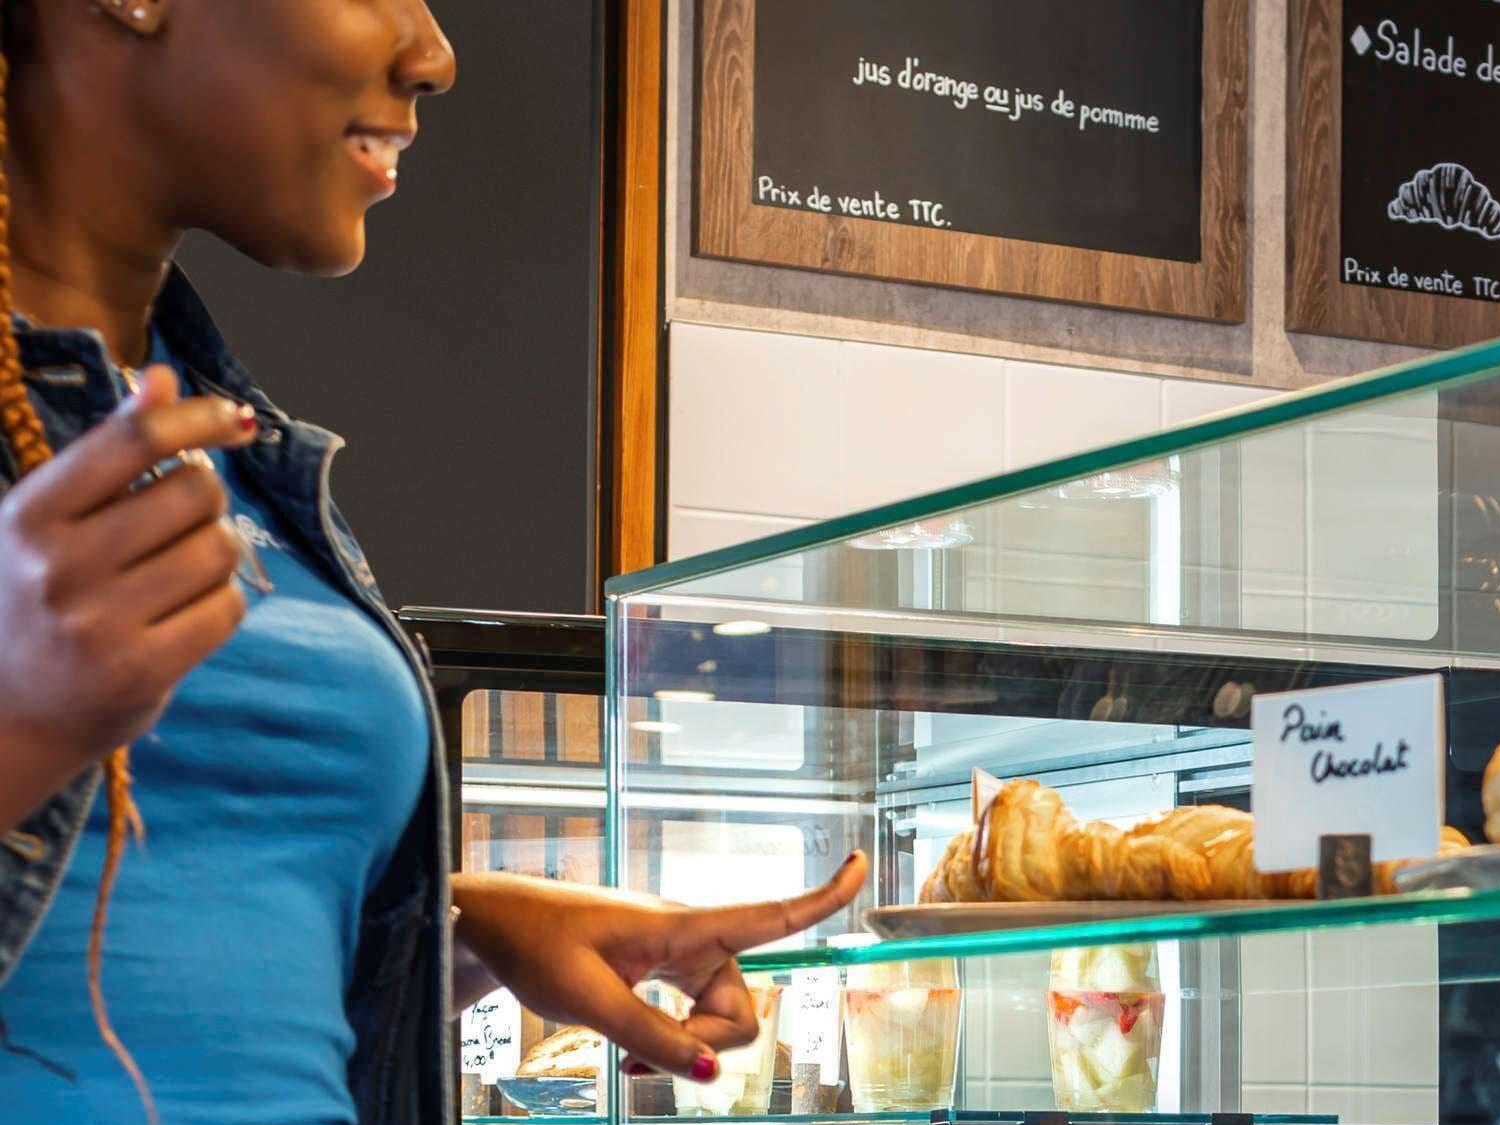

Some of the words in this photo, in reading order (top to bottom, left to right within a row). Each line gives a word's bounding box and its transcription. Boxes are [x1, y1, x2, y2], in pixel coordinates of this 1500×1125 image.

[1374, 19, 1466, 78] Salade
[854, 56, 891, 85] jus
[898, 57, 978, 109] d'orange
[984, 86, 1009, 113] ou
[1010, 87, 1043, 120] jus
[1051, 90, 1074, 117] de
[1080, 104, 1160, 133] pomme
[758, 176, 801, 206] Prix
[807, 185, 832, 212] de
[838, 188, 899, 220] vente
[908, 199, 952, 227] TTC.
[1344, 257, 1380, 284] Prix
[1388, 266, 1408, 287] de
[1414, 269, 1463, 295] vente
[1281, 704, 1344, 743] Pain
[1311, 740, 1410, 784] Chocolat
